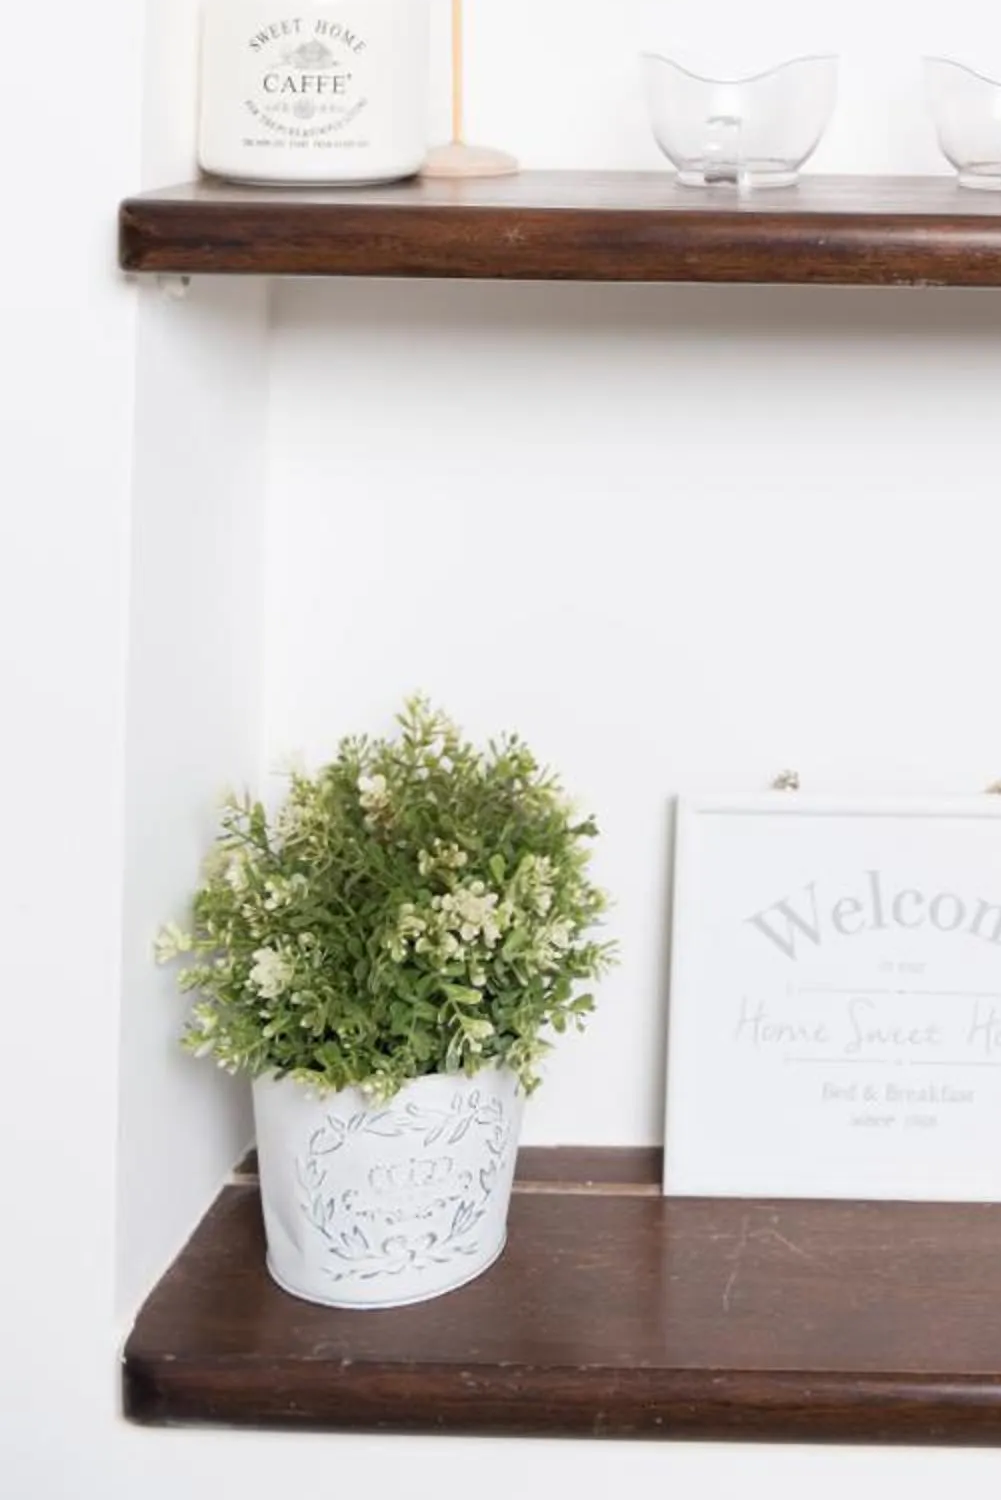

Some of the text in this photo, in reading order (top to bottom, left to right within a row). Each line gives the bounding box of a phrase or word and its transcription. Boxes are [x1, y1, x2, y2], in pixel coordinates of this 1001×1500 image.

[249, 17, 367, 54] SWEET HOME
[733, 994, 830, 1051] Home
[844, 997, 944, 1054] Sweet
